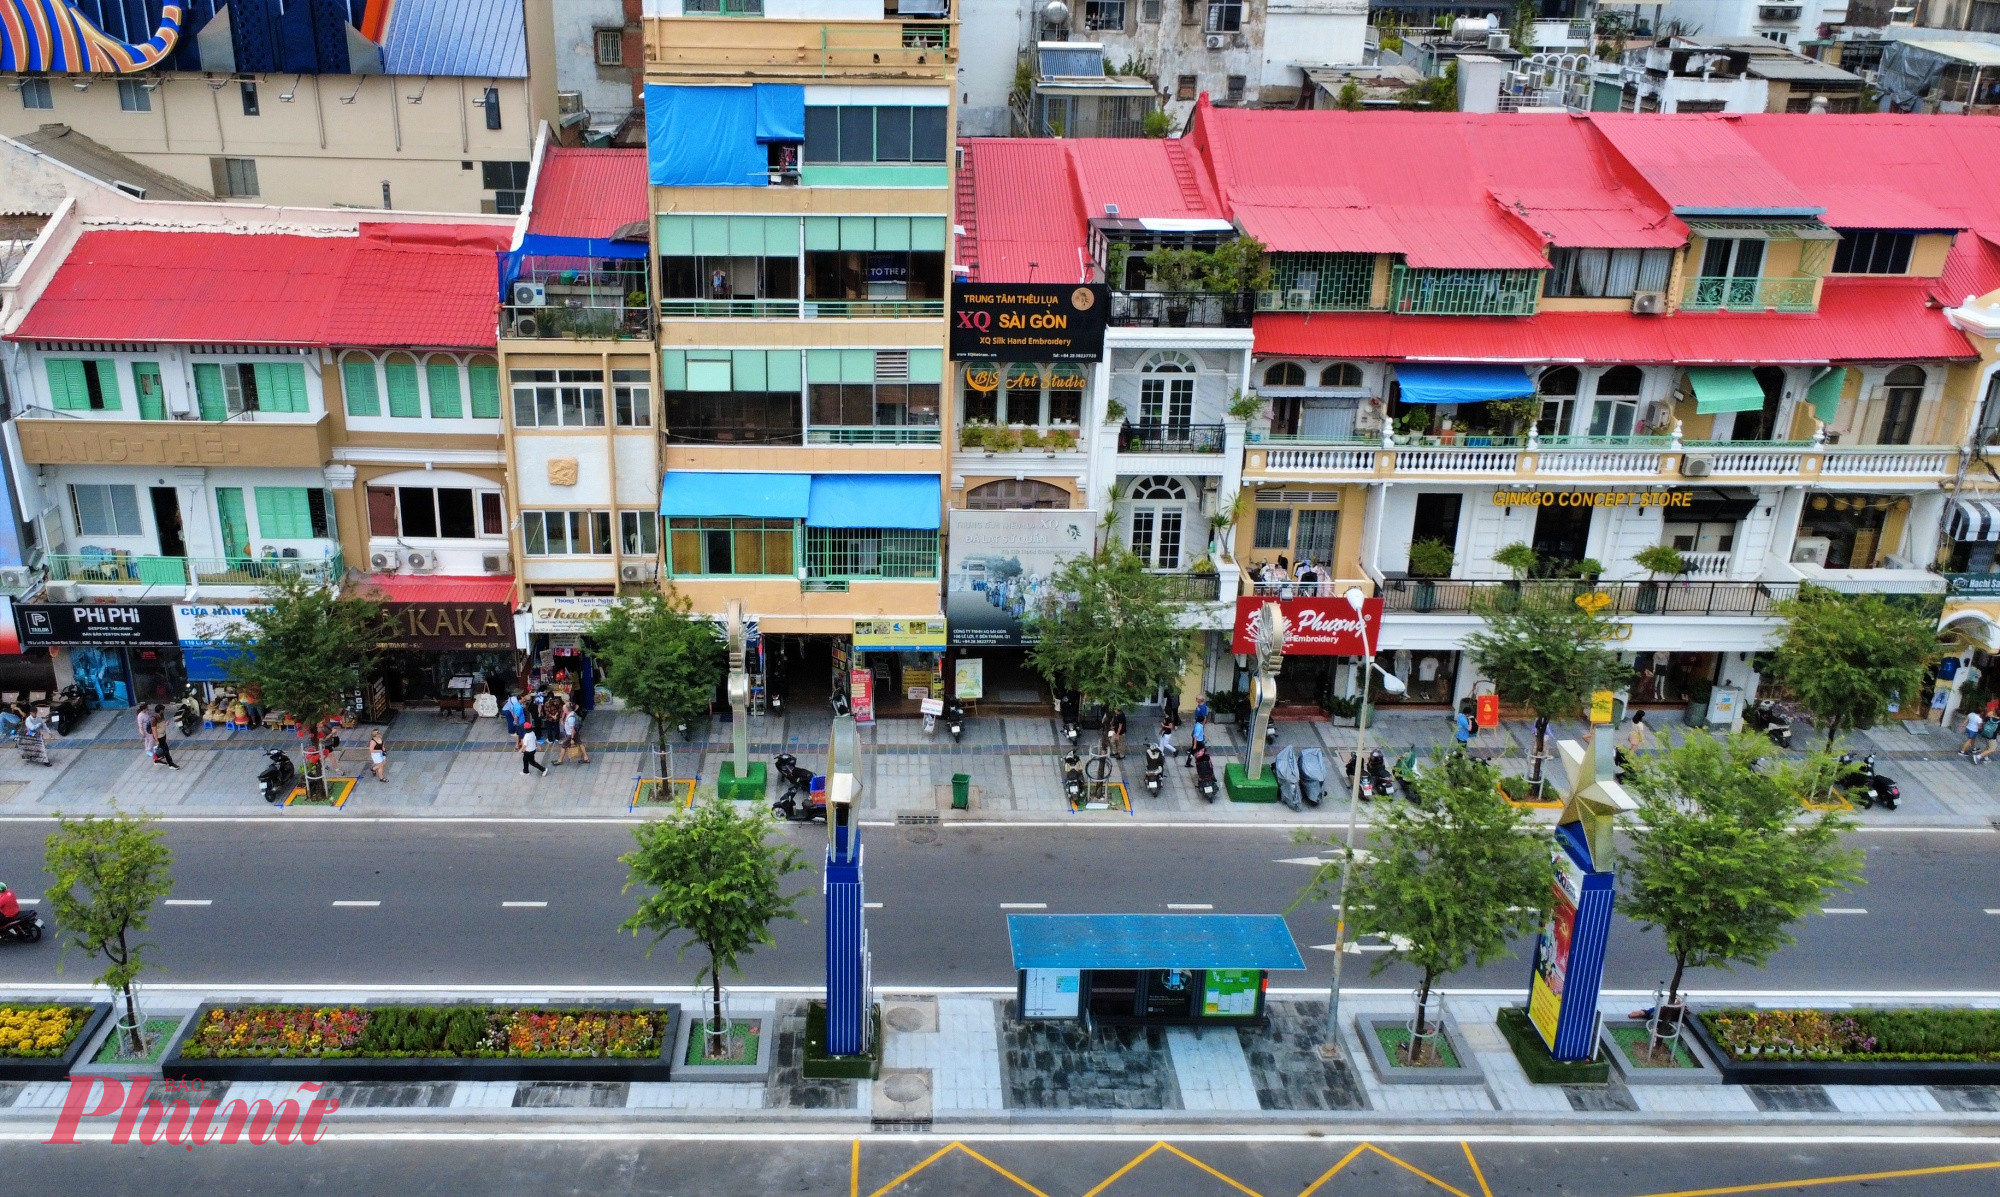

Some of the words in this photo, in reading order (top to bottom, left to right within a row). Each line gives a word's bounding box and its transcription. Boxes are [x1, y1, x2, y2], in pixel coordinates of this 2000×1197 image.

[870, 267, 883, 276] TO
[884, 267, 899, 276] THE
[963, 294, 994, 304] TRUNG
[996, 293, 1016, 304] TÂM
[1017, 293, 1040, 304] THÊU
[1041, 295, 1059, 307] LỤA
[956, 310, 992, 333] XQ
[998, 310, 1026, 329] SÀI
[1029, 310, 1067, 329] GÒN
[979, 336, 991, 345] XQ
[992, 336, 1006, 345] Silk
[1007, 337, 1027, 345] Hand
[1028, 337, 1072, 347] Embroidery
[1005, 371, 1038, 390] Art
[1040, 371, 1087, 390] Studio
[1493, 491, 1554, 507] GINKGO
[1558, 491, 1635, 507] CONCEPT
[1639, 492, 1693, 507] STORE
[1040, 519, 1060, 531] XQ
[1969, 578, 1991, 588] Hachi
[1991, 578, 2000, 588] Sa
[554, 597, 575, 605] Phòng
[181, 604, 208, 616] CỬA
[408, 608, 506, 637] KAKA
